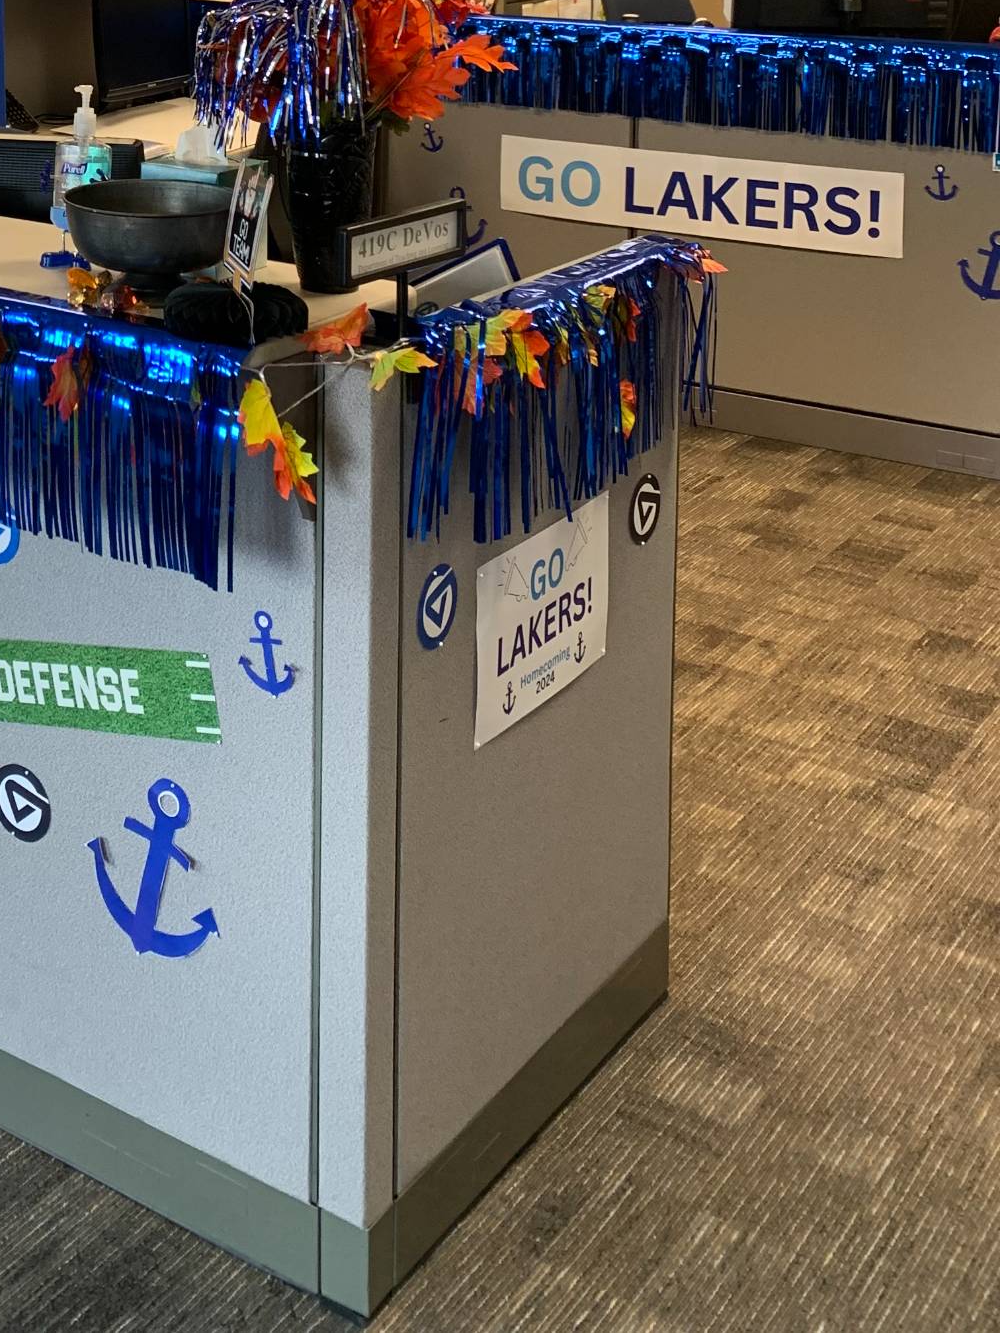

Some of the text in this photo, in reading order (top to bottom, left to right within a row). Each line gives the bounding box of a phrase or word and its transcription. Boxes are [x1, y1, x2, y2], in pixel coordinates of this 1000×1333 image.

[518, 155, 881, 239] GO LAKERS!
[232, 233, 251, 265] TEAM
[239, 218, 249, 240] GO
[358, 230, 398, 259] 419C
[403, 220, 449, 247] DeVos
[530, 547, 564, 601] GO
[497, 576, 593, 677] LAKERS!
[520, 645, 572, 690] Homecoming
[535, 670, 555, 694] 2024
